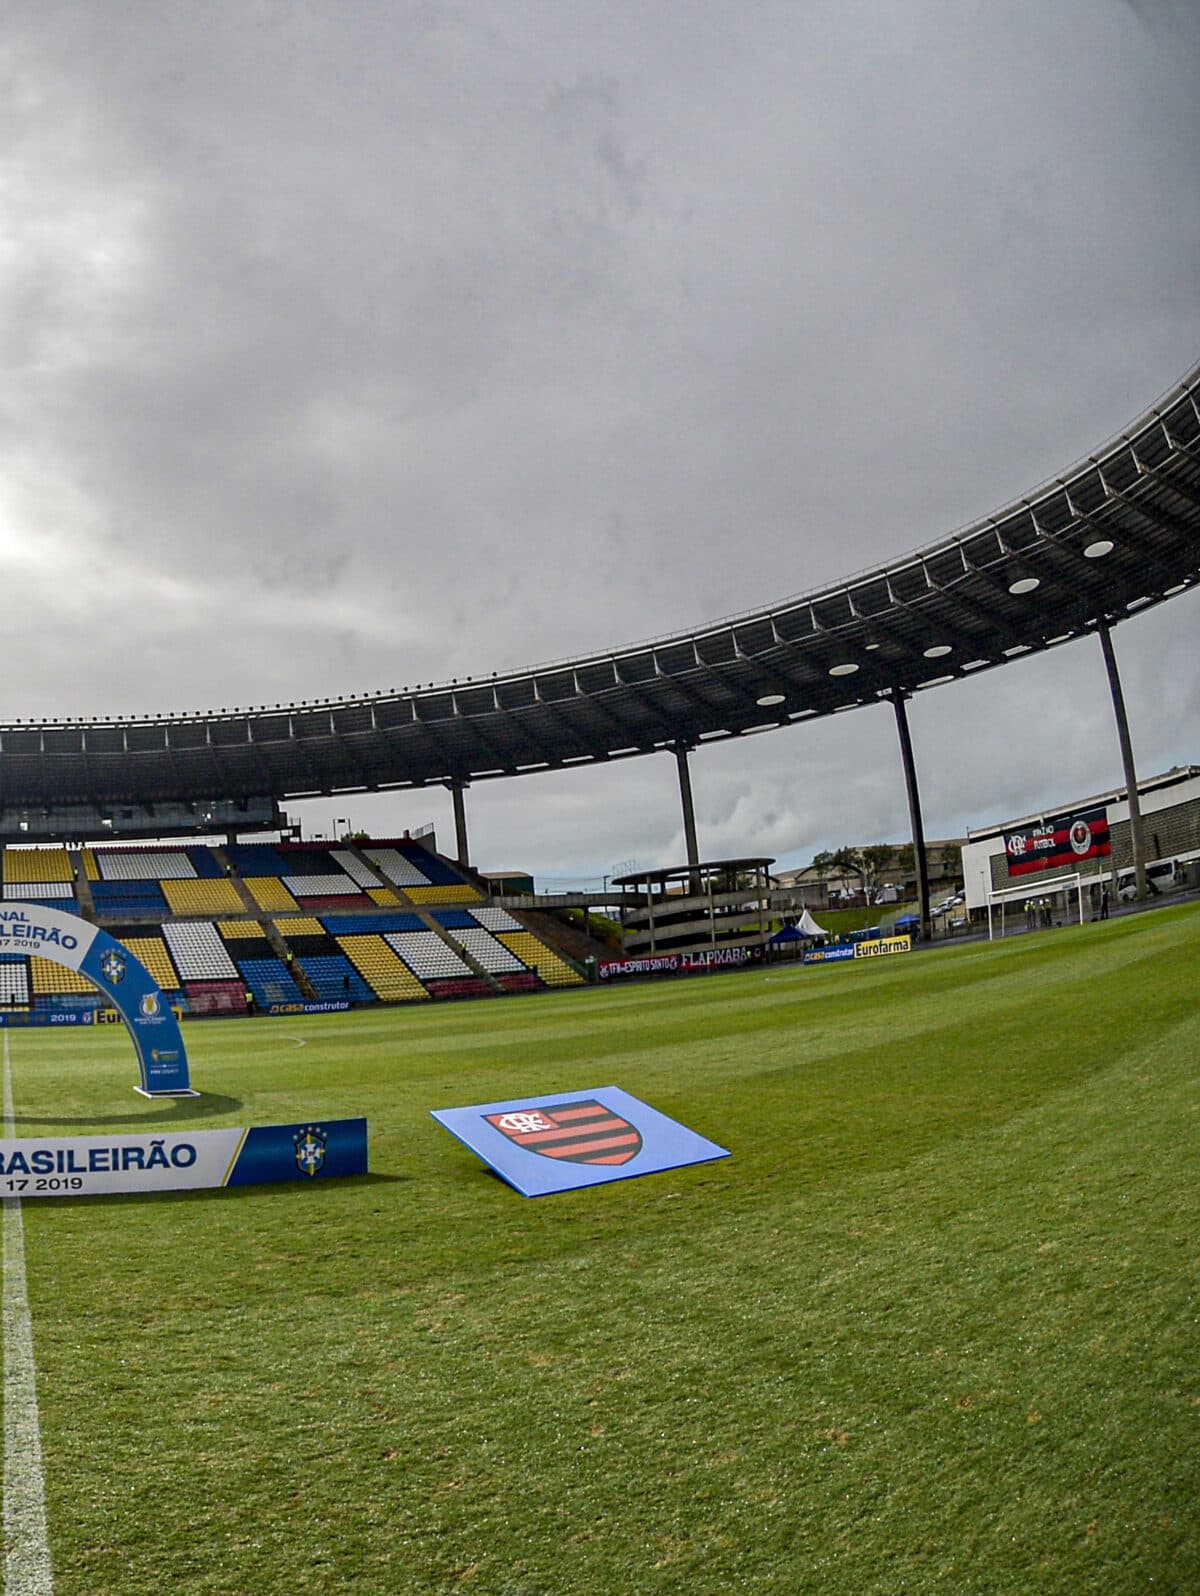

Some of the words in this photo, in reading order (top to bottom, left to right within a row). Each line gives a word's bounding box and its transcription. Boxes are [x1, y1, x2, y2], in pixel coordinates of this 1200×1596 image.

[0, 939, 10, 947] 17
[14, 939, 41, 949] 2019
[855, 940, 909, 957] Eurofarma
[304, 1001, 349, 1011] construtor
[50, 1014, 76, 1022] 2019
[6, 1179, 29, 1192] 17
[35, 1177, 83, 1191] 2019
